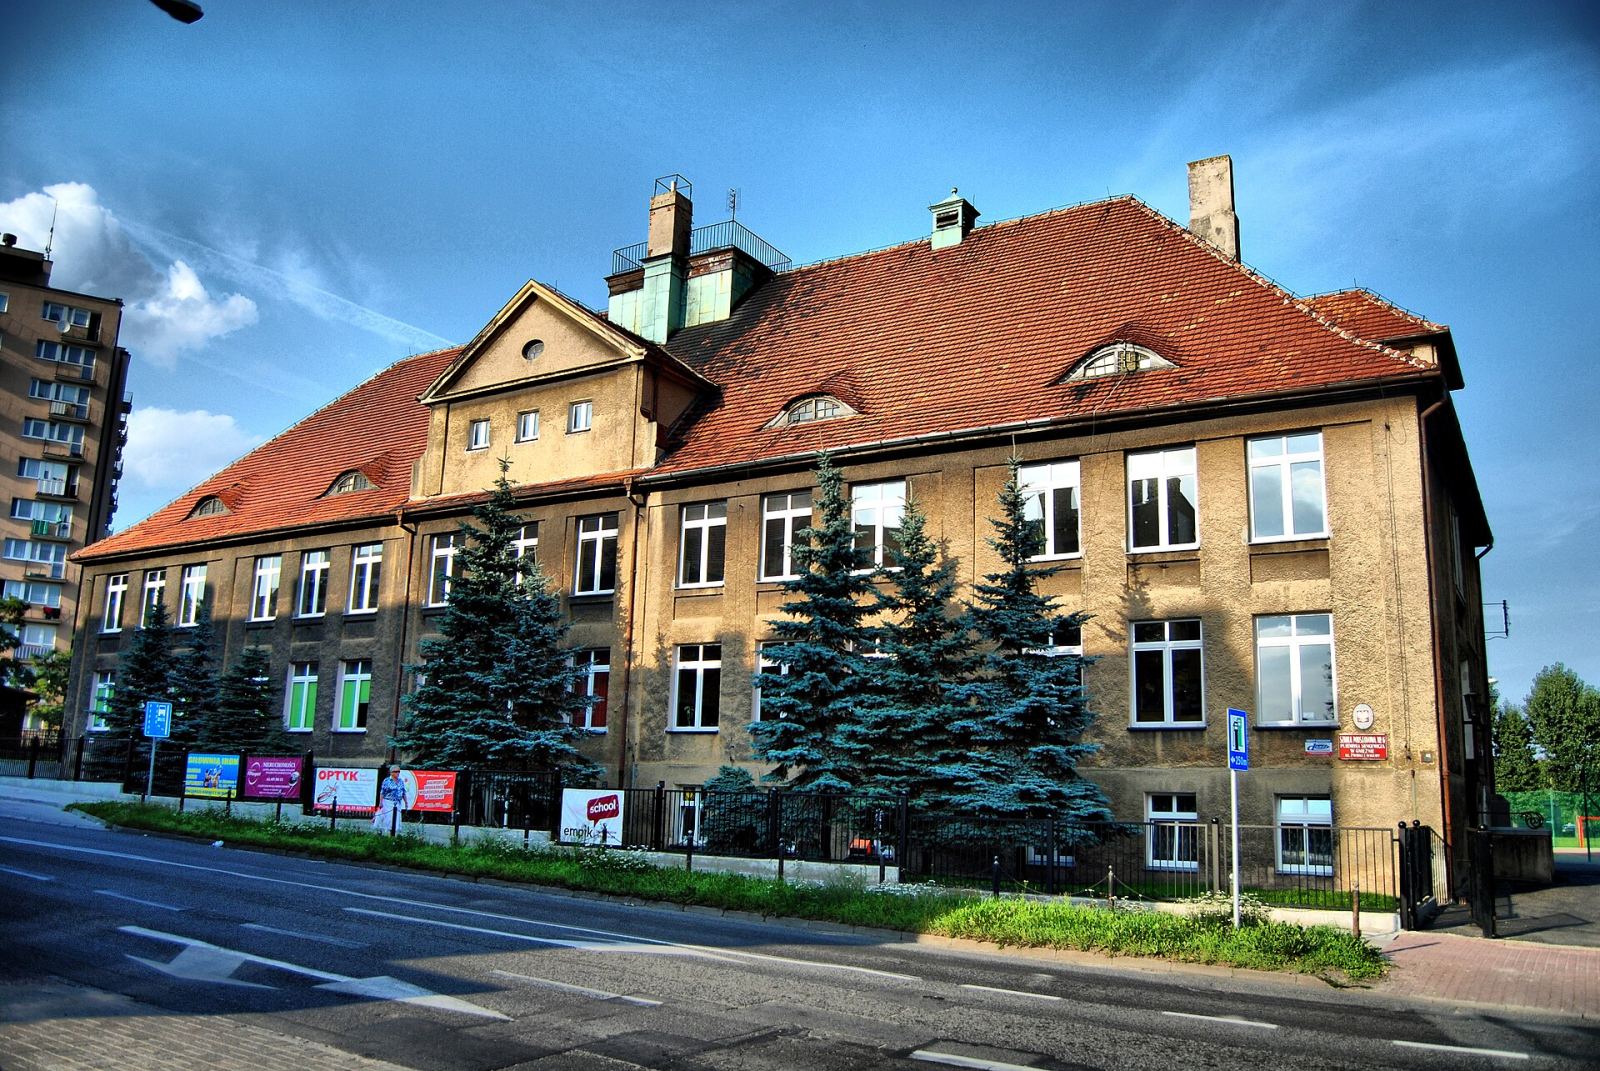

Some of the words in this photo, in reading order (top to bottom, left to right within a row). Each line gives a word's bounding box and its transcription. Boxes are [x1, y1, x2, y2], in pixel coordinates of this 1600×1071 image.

[318, 770, 359, 781] OPTYK
[590, 799, 616, 813] school
[564, 825, 593, 838] empik
